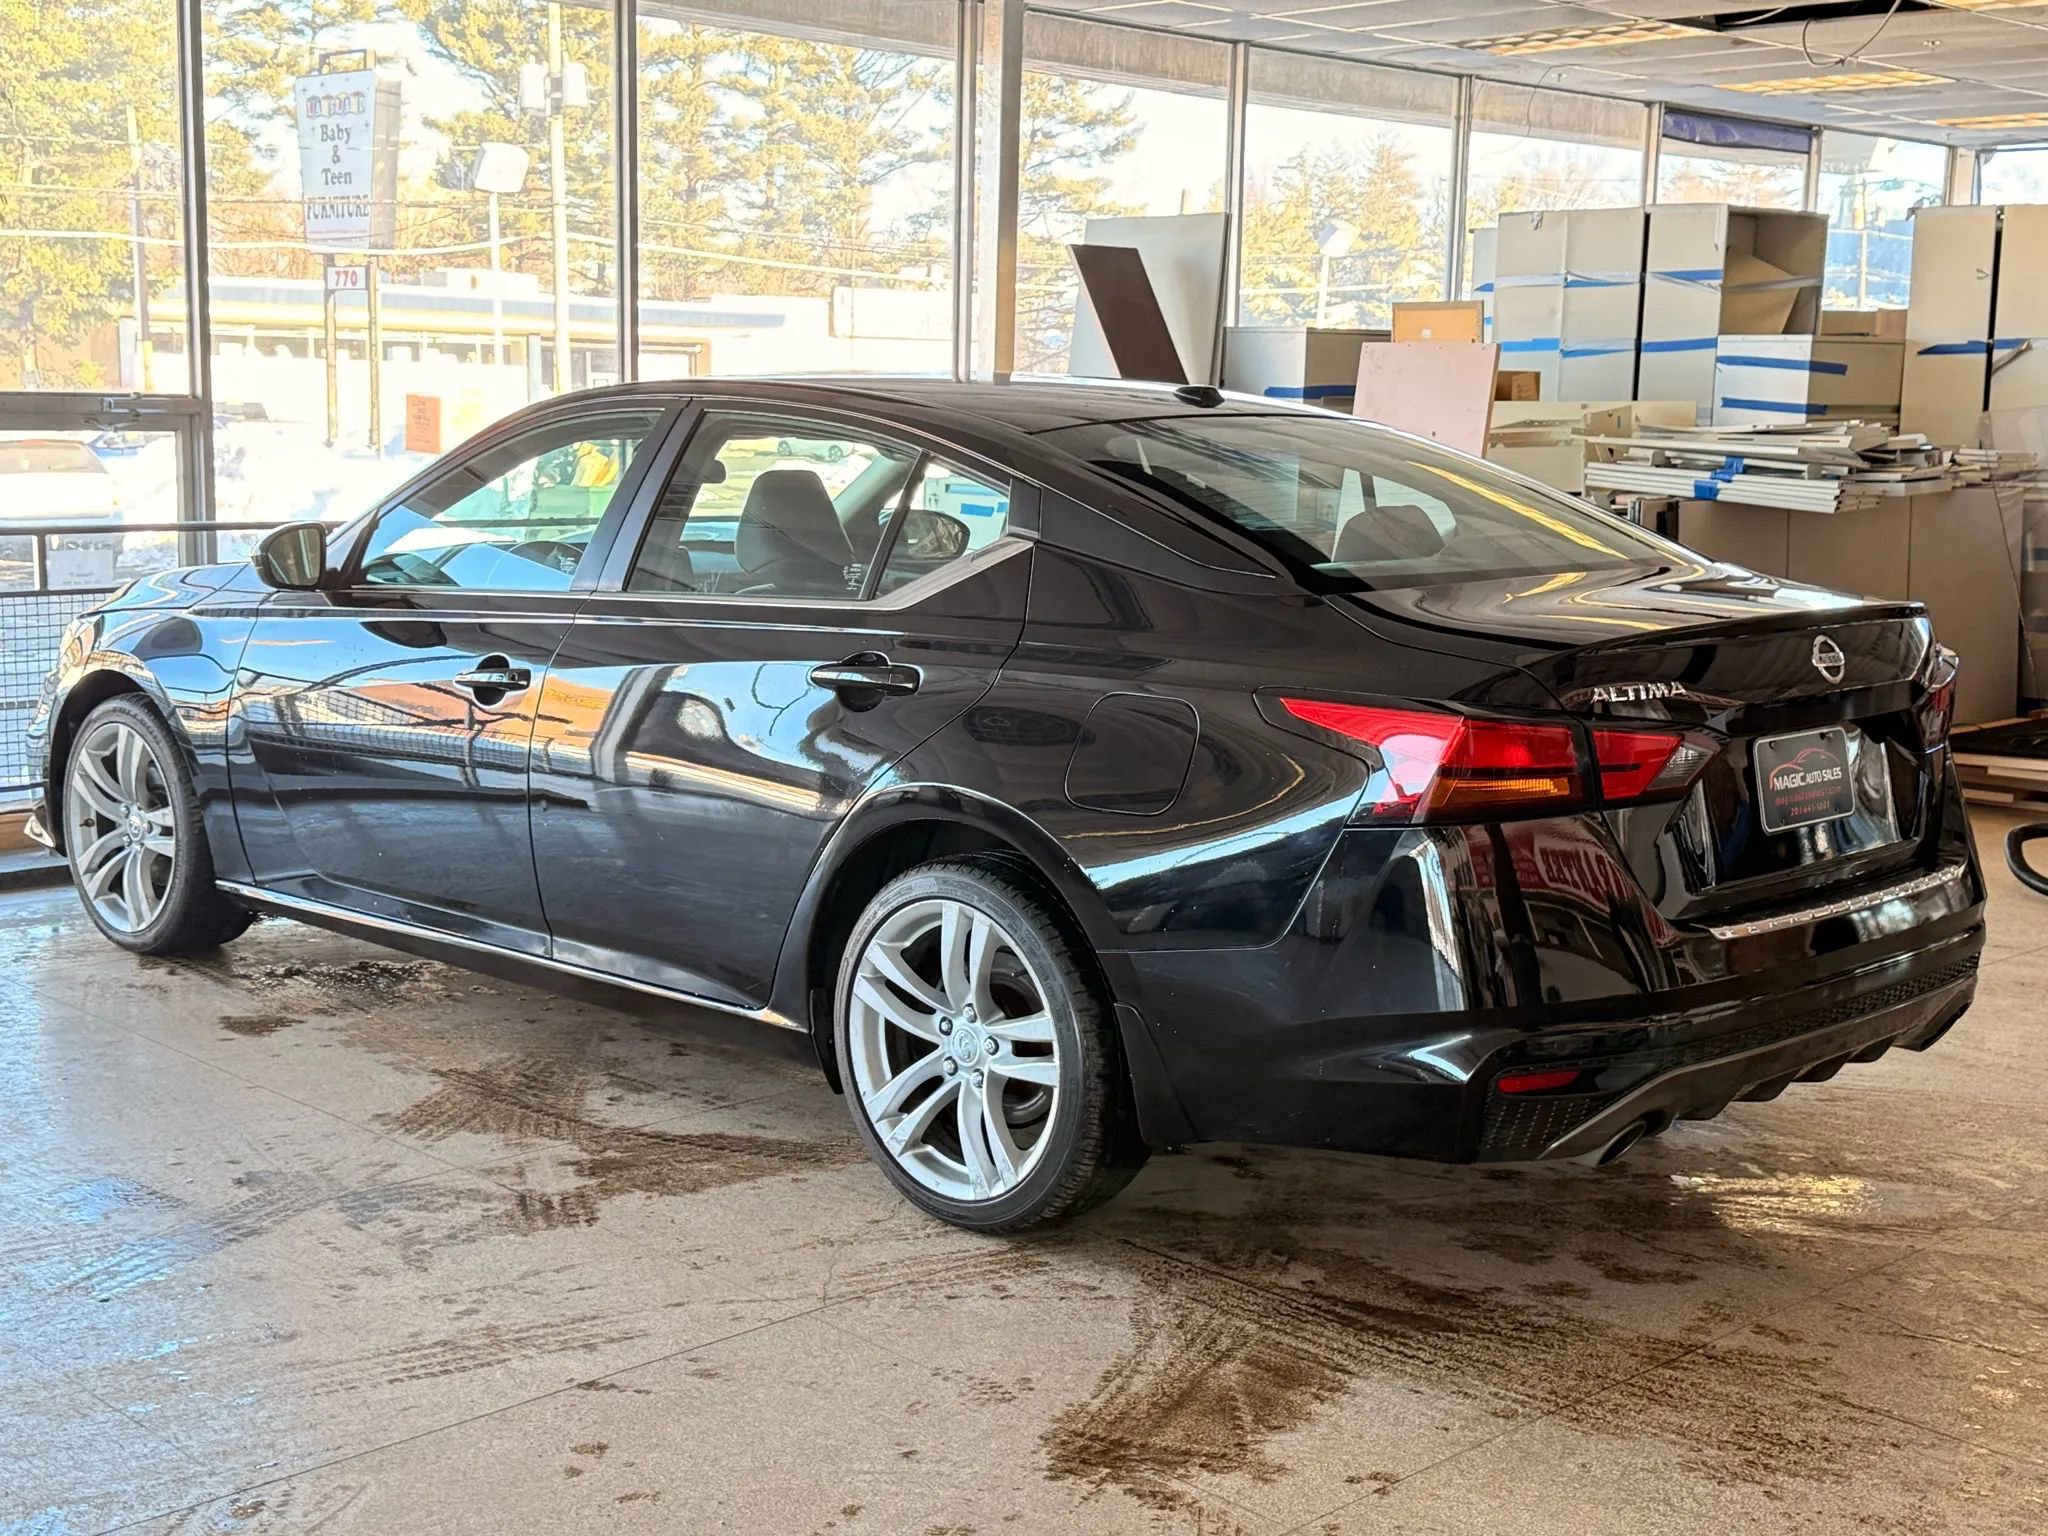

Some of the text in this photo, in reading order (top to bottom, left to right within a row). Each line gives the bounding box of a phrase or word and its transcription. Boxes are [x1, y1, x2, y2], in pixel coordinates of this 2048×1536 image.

[320, 123, 352, 145] Baby
[331, 144, 341, 165] &
[321, 167, 352, 186] Teen
[307, 194, 369, 220] FURNITURE
[335, 270, 357, 287] 770
[1590, 681, 1687, 704] ALTIMA
[1773, 766, 1842, 791] MAGIC AUTO SALES
